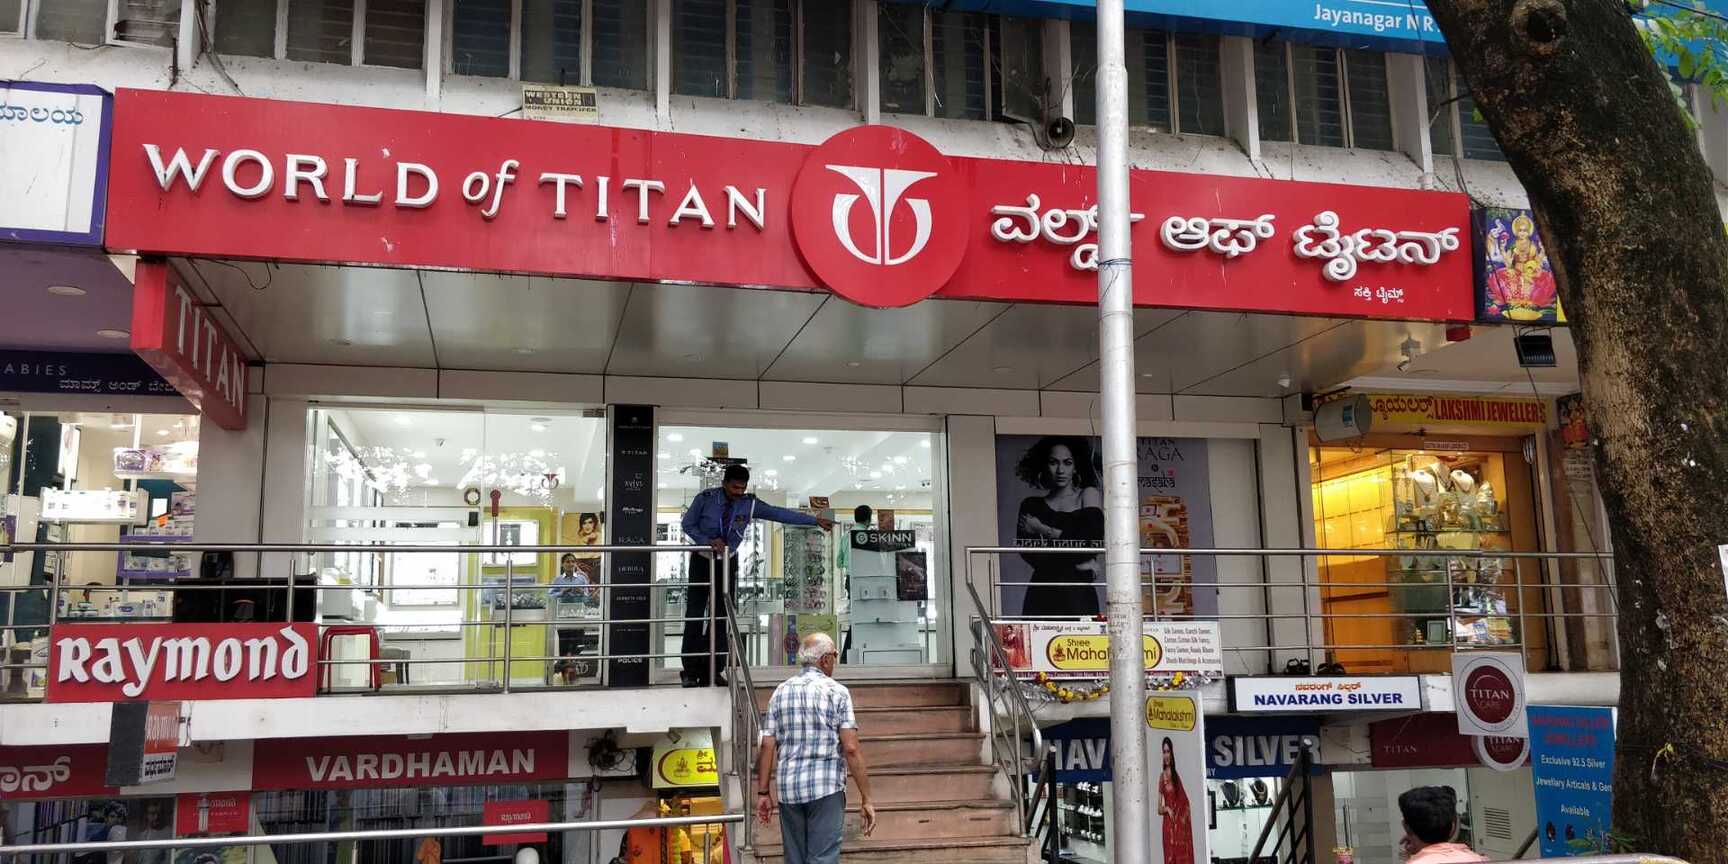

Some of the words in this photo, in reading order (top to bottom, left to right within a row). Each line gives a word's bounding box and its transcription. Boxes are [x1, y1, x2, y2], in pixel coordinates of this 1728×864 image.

[1314, 4, 1402, 31] Jayanagar
[543, 98, 582, 106] UNION
[142, 143, 440, 208] WORLD
[462, 159, 519, 219] of
[538, 172, 767, 232] TITAN
[1292, 210, 1460, 282] ಟೈಟನ್
[175, 284, 246, 417] TITAN
[3, 363, 68, 376] ABIES
[1434, 399, 1486, 421] LAKSHMI
[1486, 401, 1547, 423] JEWELLERS
[869, 533, 912, 543] SKINN
[1067, 638, 1090, 647] Shree
[56, 626, 310, 697] Raymond
[1254, 694, 1343, 706] NAVARANG
[1347, 693, 1403, 705] SILVER
[1470, 688, 1510, 700] TITAN
[1214, 734, 1321, 767] SILVER
[1382, 744, 1417, 753] TITAN
[305, 749, 535, 782] VARDHAMAN
[1541, 754, 1570, 766] Exclusive
[1587, 758, 1606, 769] Silver
[1561, 804, 1590, 817] Available
